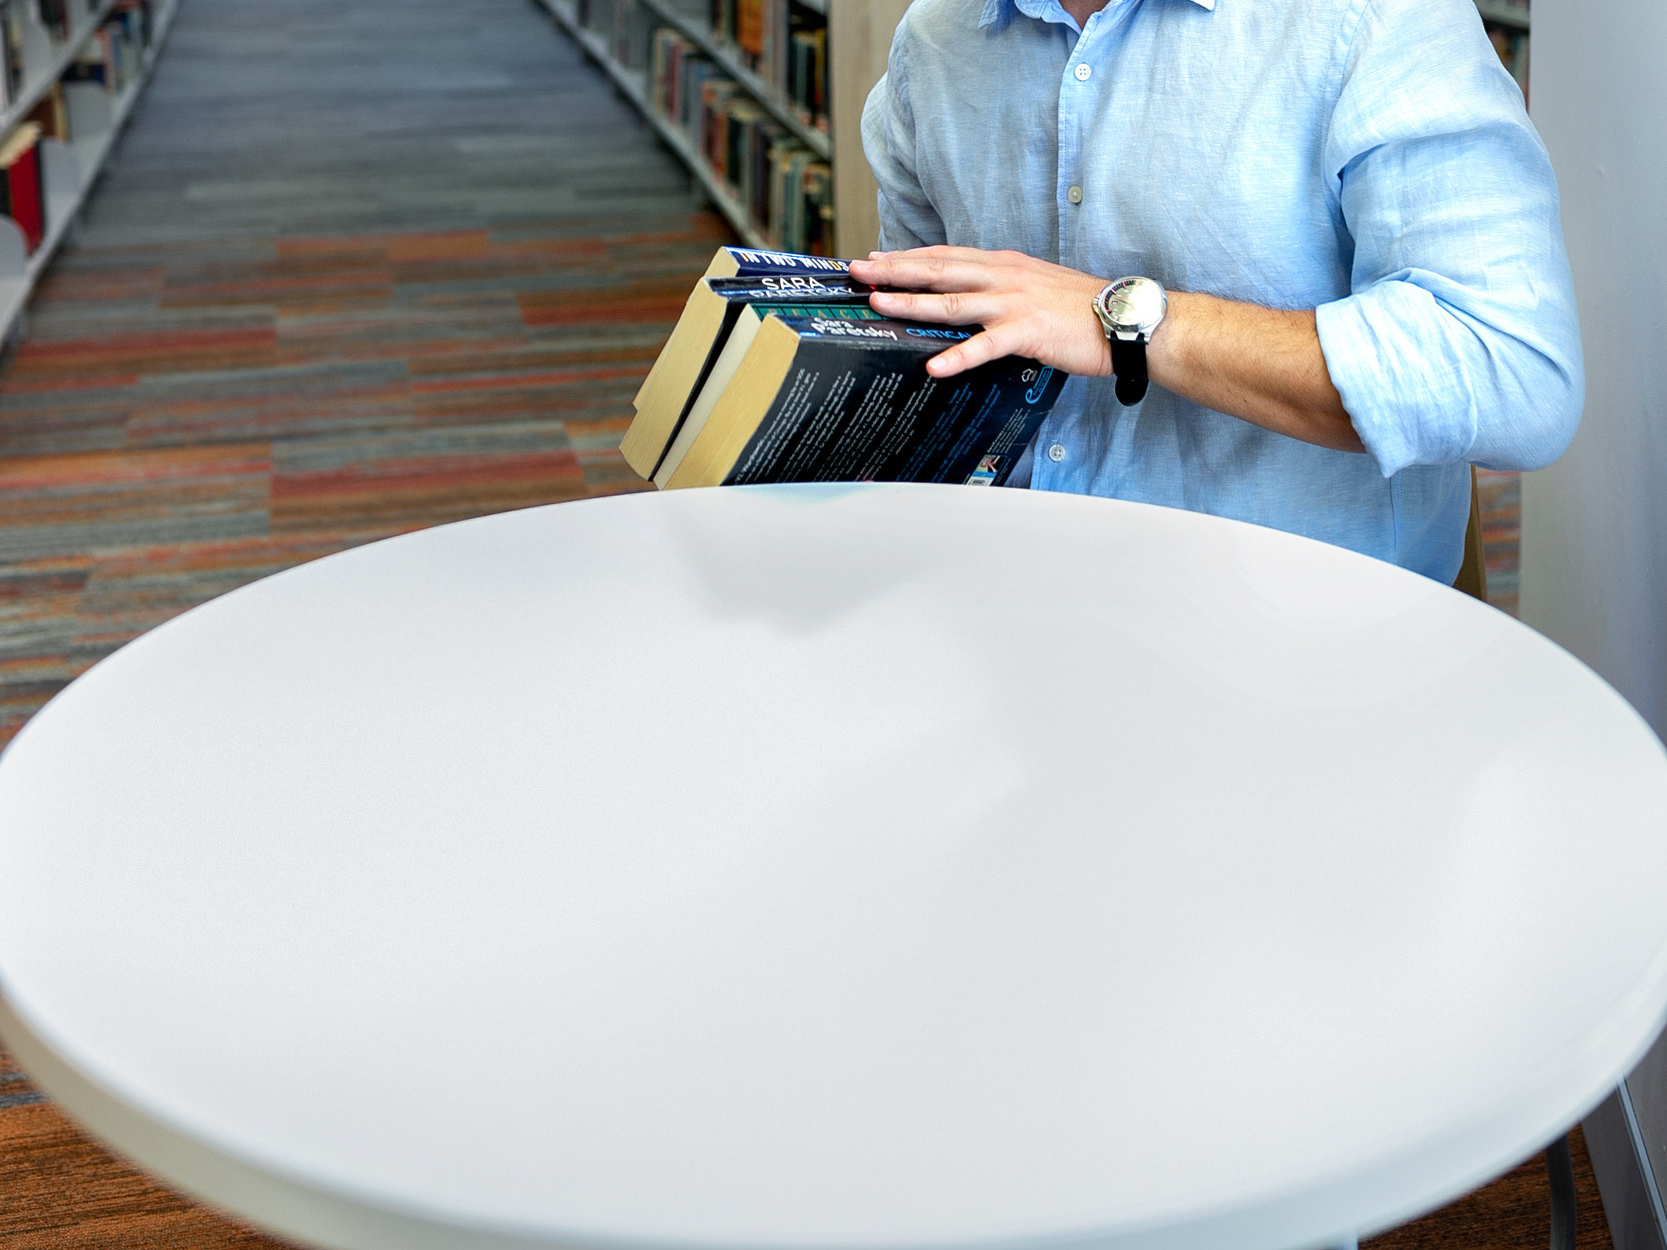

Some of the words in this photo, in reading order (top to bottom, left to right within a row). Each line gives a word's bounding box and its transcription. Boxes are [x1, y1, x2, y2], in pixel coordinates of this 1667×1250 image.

[741, 252, 760, 263] IN
[758, 253, 797, 267] TWO
[801, 258, 850, 271] MINDS
[761, 277, 825, 290] SARA
[814, 317, 854, 329] Sara
[811, 323, 898, 341] Paretsky
